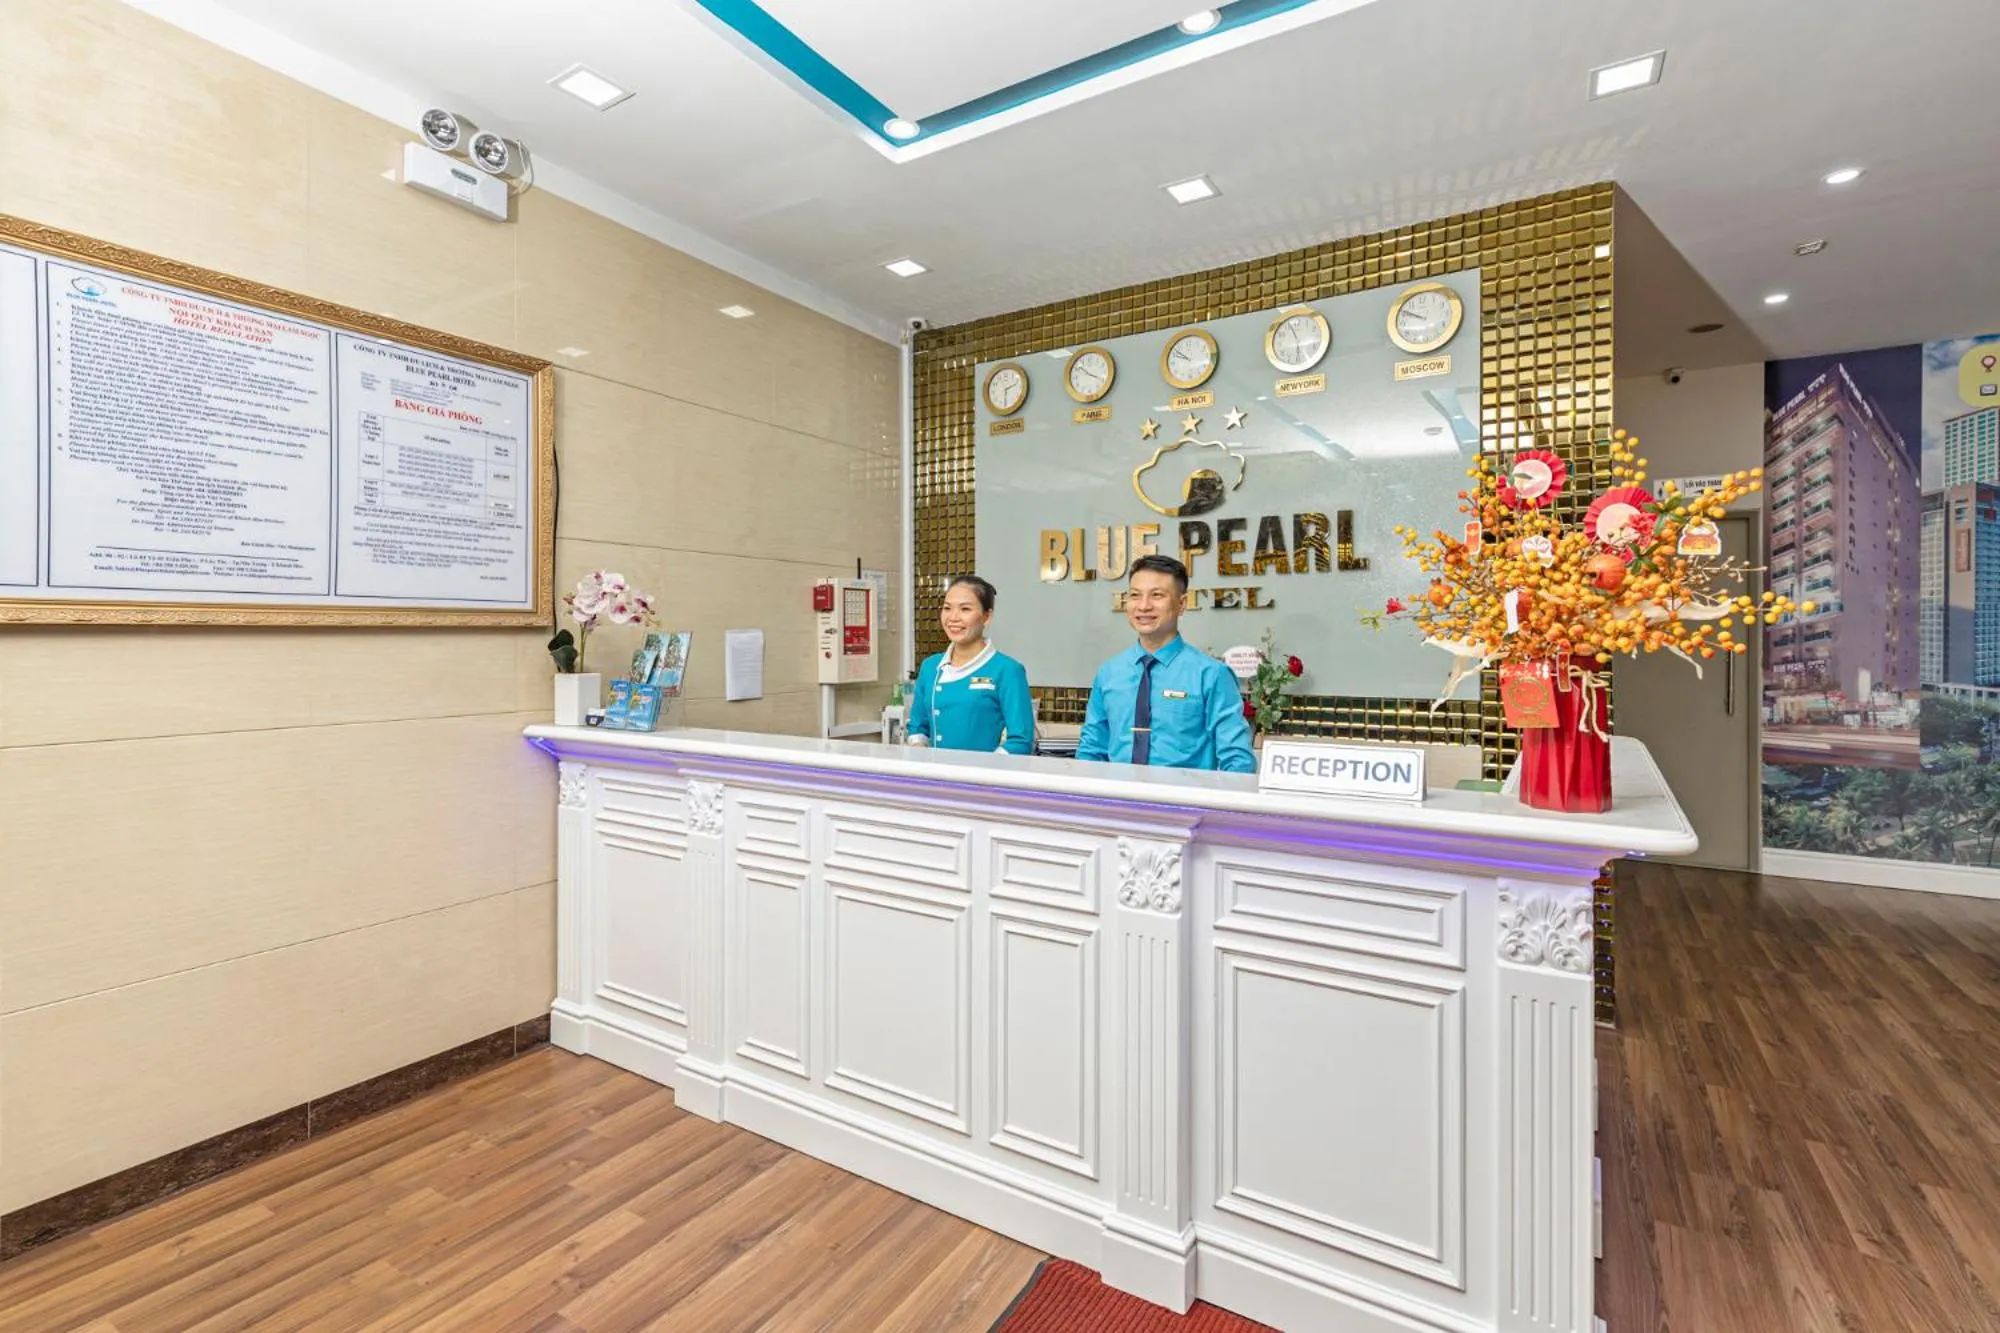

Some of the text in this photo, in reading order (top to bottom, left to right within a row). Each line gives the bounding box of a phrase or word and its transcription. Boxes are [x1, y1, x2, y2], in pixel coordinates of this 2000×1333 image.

[173, 316, 273, 345] HOTEL REGULATION
[405, 365, 427, 377] BLUE
[1401, 361, 1445, 374] MOSCOW
[1280, 379, 1321, 391] NEWYORK
[1040, 509, 1371, 583] BLUE PEARL
[1112, 586, 1276, 613] HTEL
[1271, 754, 1413, 784] RECEPTION
